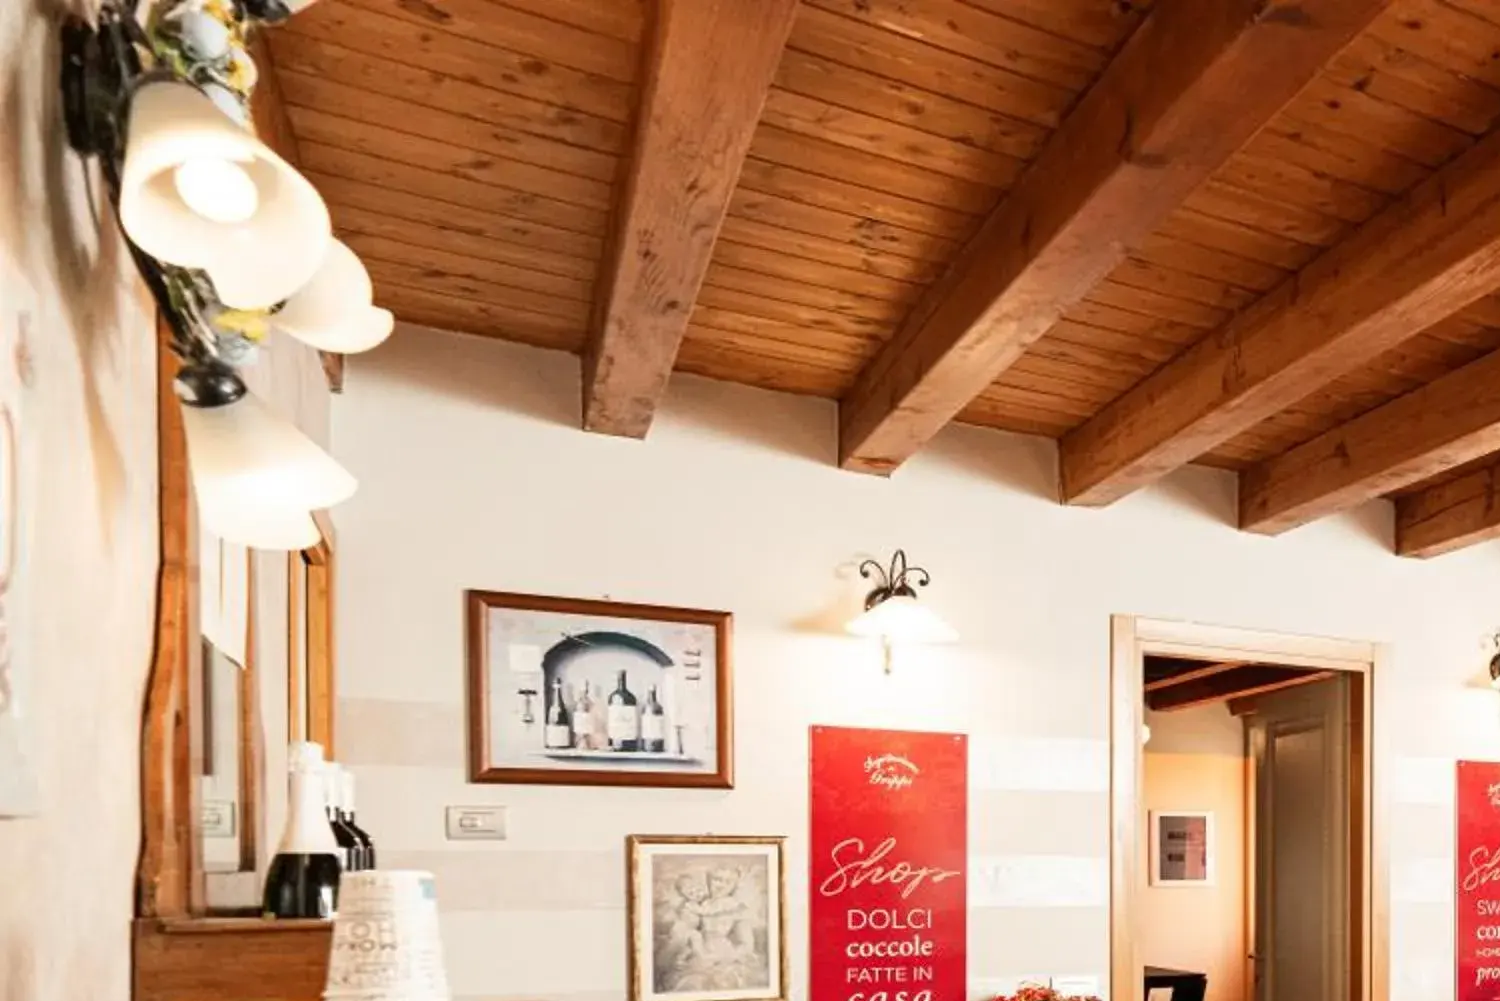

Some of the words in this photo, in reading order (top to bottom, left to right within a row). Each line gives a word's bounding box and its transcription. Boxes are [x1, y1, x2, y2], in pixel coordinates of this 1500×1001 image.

[820, 837, 962, 900] Shop
[847, 908, 932, 930] DOLCI
[846, 934, 933, 958] coccole
[847, 966, 907, 983] FATTE
[913, 965, 933, 981] IN
